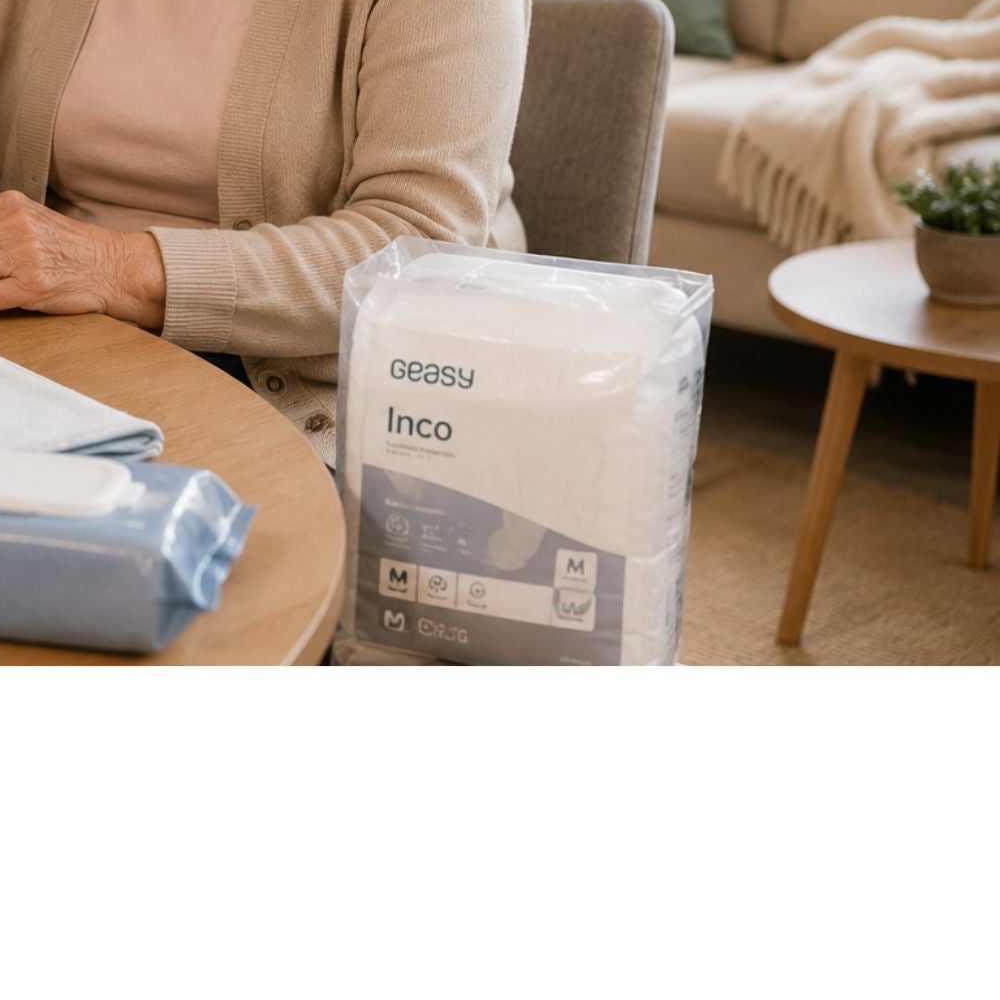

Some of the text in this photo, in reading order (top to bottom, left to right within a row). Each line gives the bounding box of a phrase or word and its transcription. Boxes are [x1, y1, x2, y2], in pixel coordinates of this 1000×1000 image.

[388, 406, 453, 442] Inco
[566, 558, 585, 575] M
[389, 567, 408, 585] M
